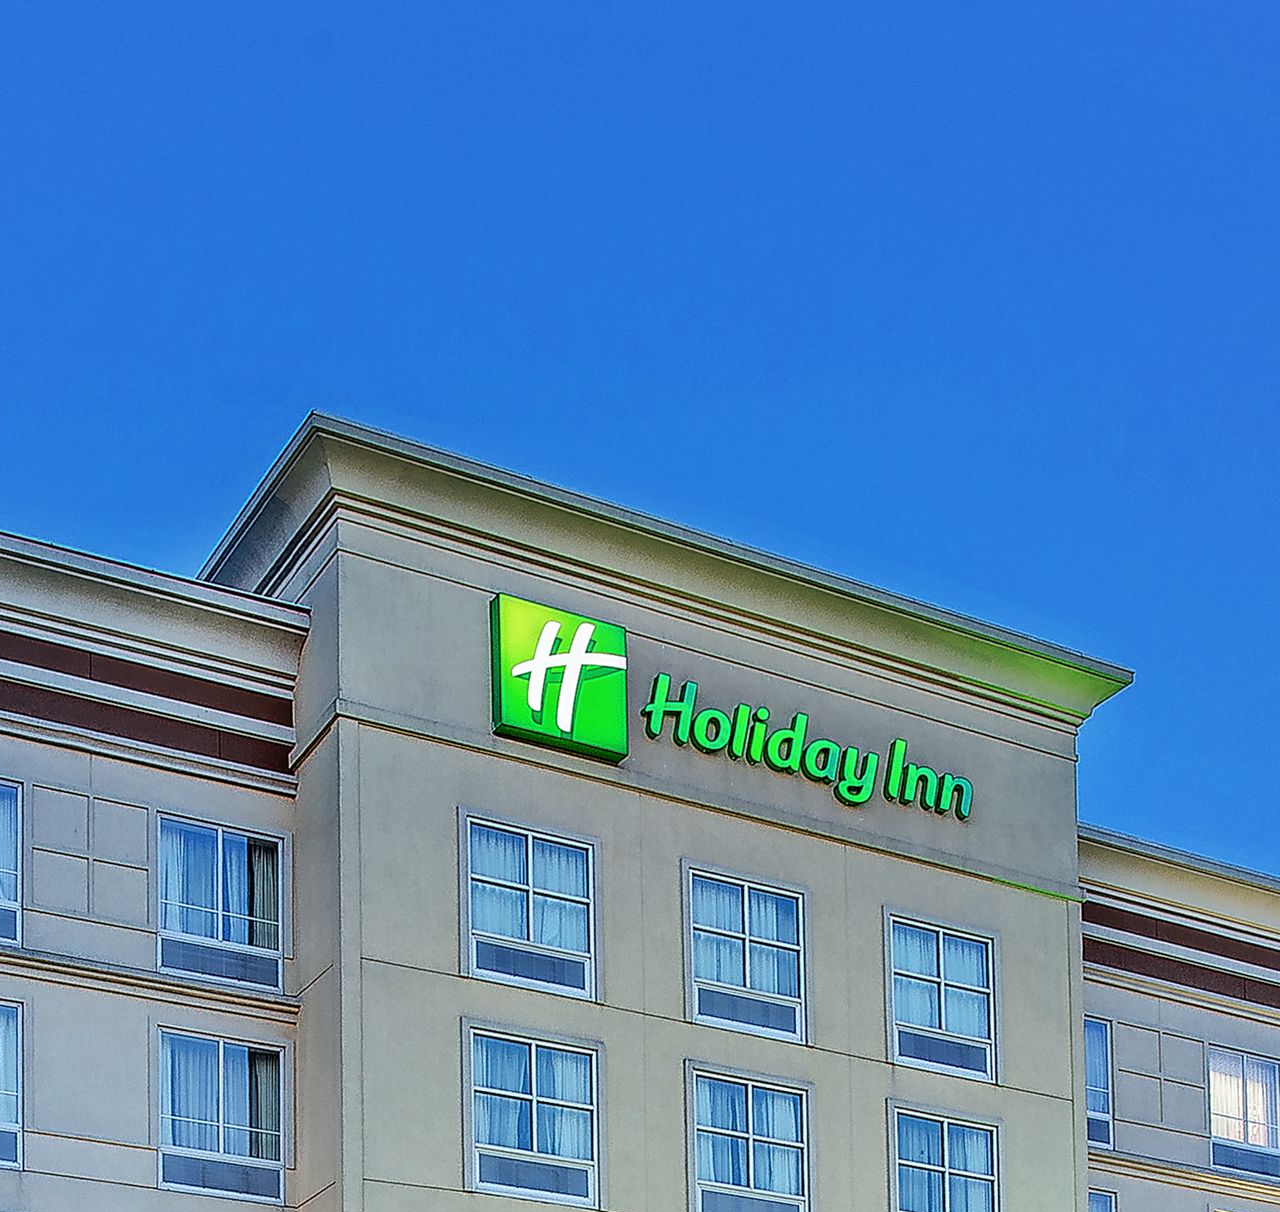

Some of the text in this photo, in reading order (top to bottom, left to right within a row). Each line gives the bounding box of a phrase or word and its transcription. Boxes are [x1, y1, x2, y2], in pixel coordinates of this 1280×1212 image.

[512, 620, 628, 732] H
[641, 673, 974, 821] Holiday Inn
